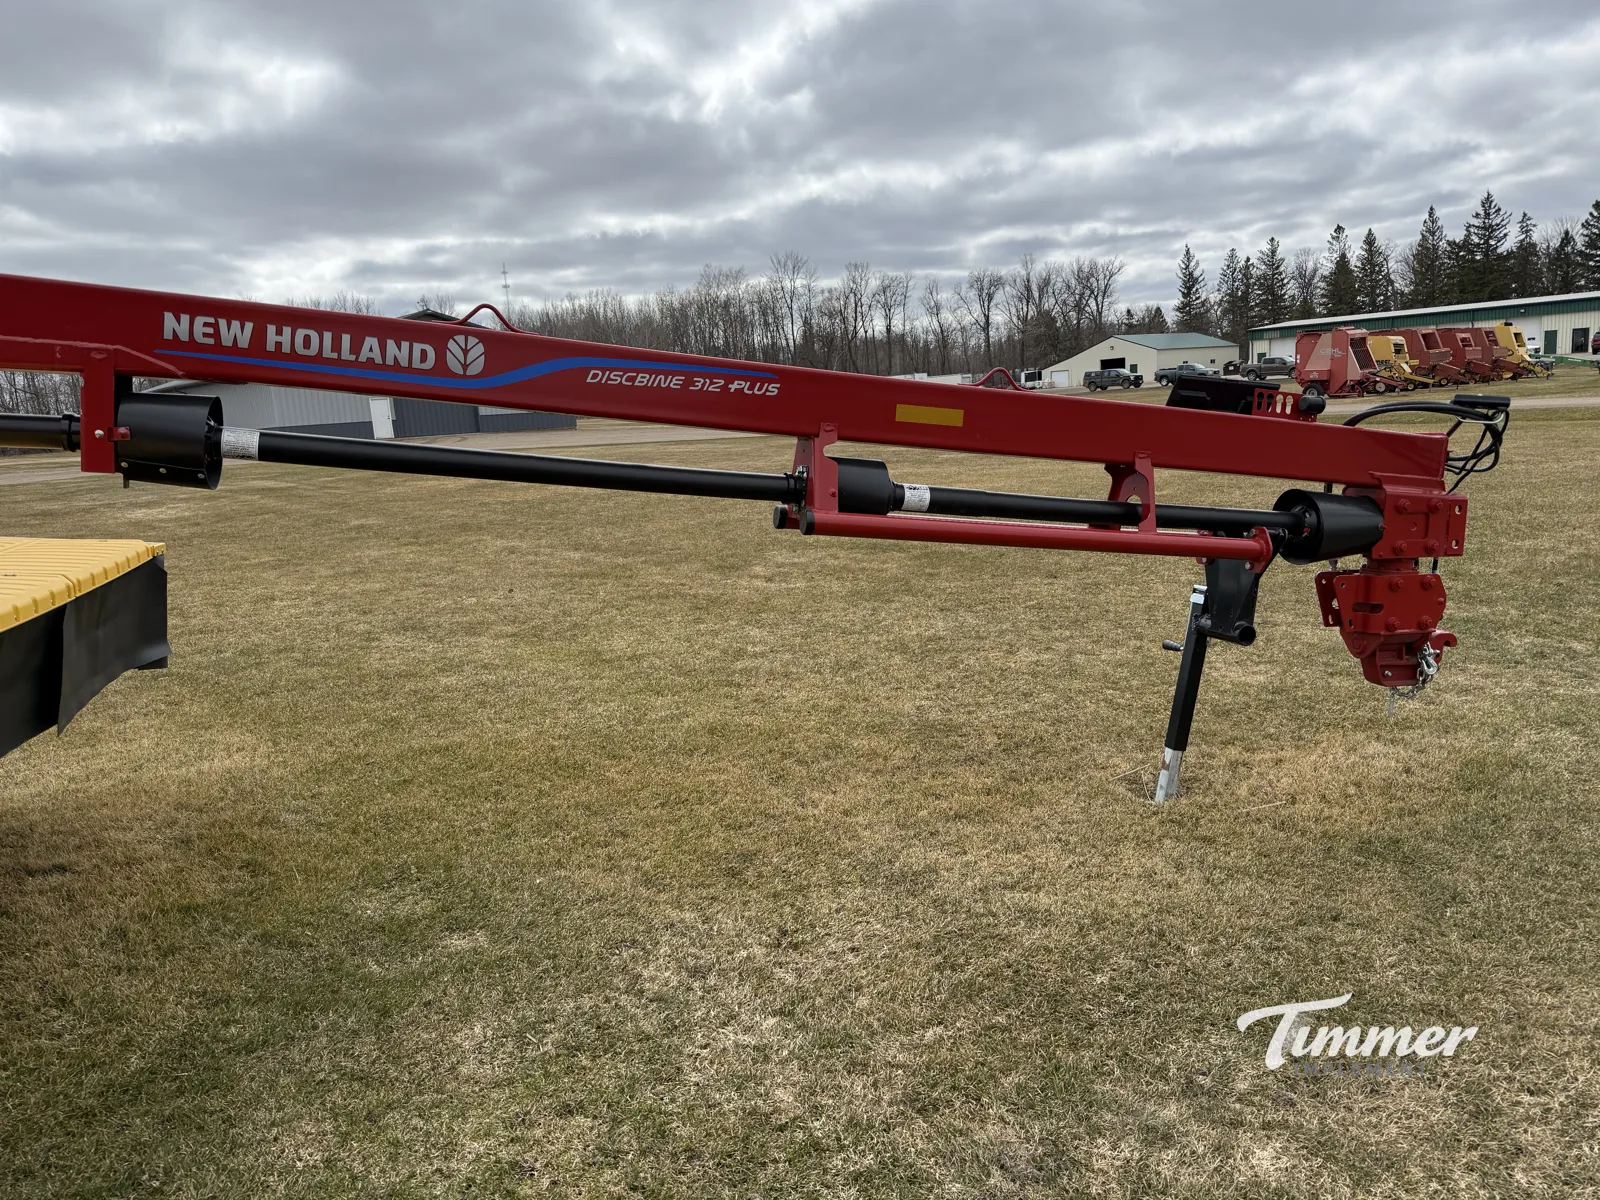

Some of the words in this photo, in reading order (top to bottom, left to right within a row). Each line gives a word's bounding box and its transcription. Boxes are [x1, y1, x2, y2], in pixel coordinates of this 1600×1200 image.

[163, 311, 254, 349] NEW
[265, 323, 436, 370] HOLLAND
[586, 369, 685, 389] DISCBINE
[689, 378, 725, 392] 312
[728, 380, 781, 396] PLUS
